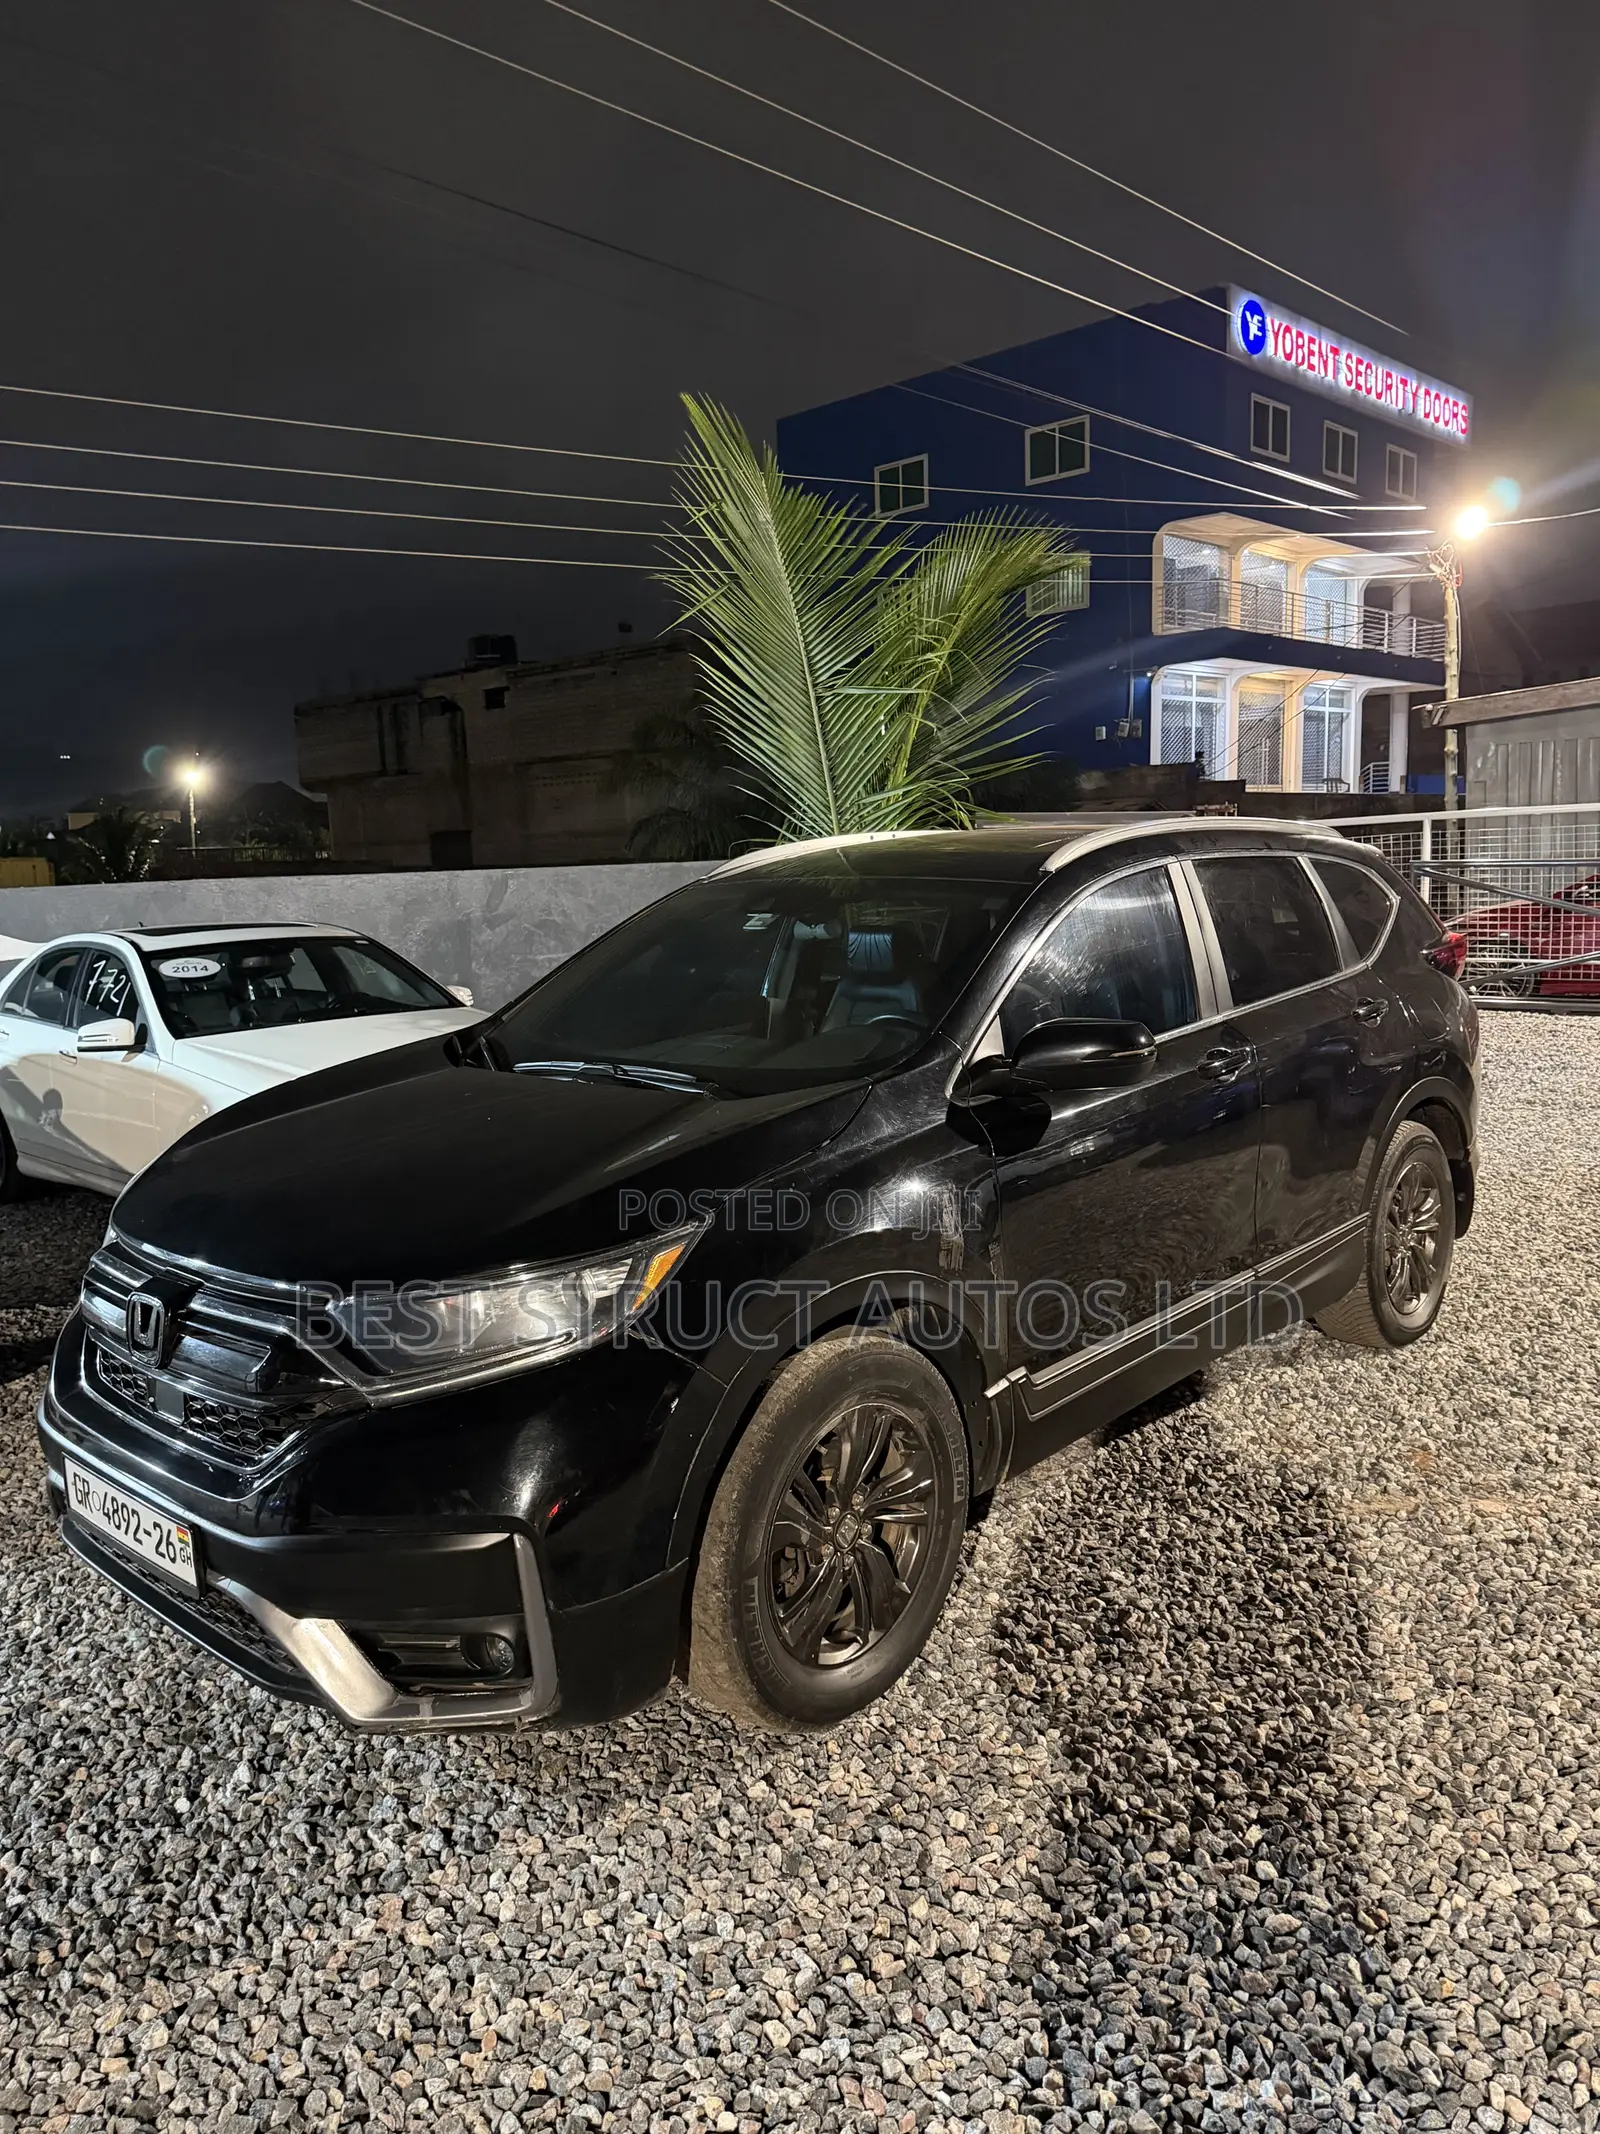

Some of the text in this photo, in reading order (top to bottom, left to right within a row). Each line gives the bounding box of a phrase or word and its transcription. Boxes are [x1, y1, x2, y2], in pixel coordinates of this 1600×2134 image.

[1269, 316, 1469, 435] YOBENT SECURITY DOORS
[171, 965, 209, 973] 2014
[179, 1547, 193, 1568] GH
